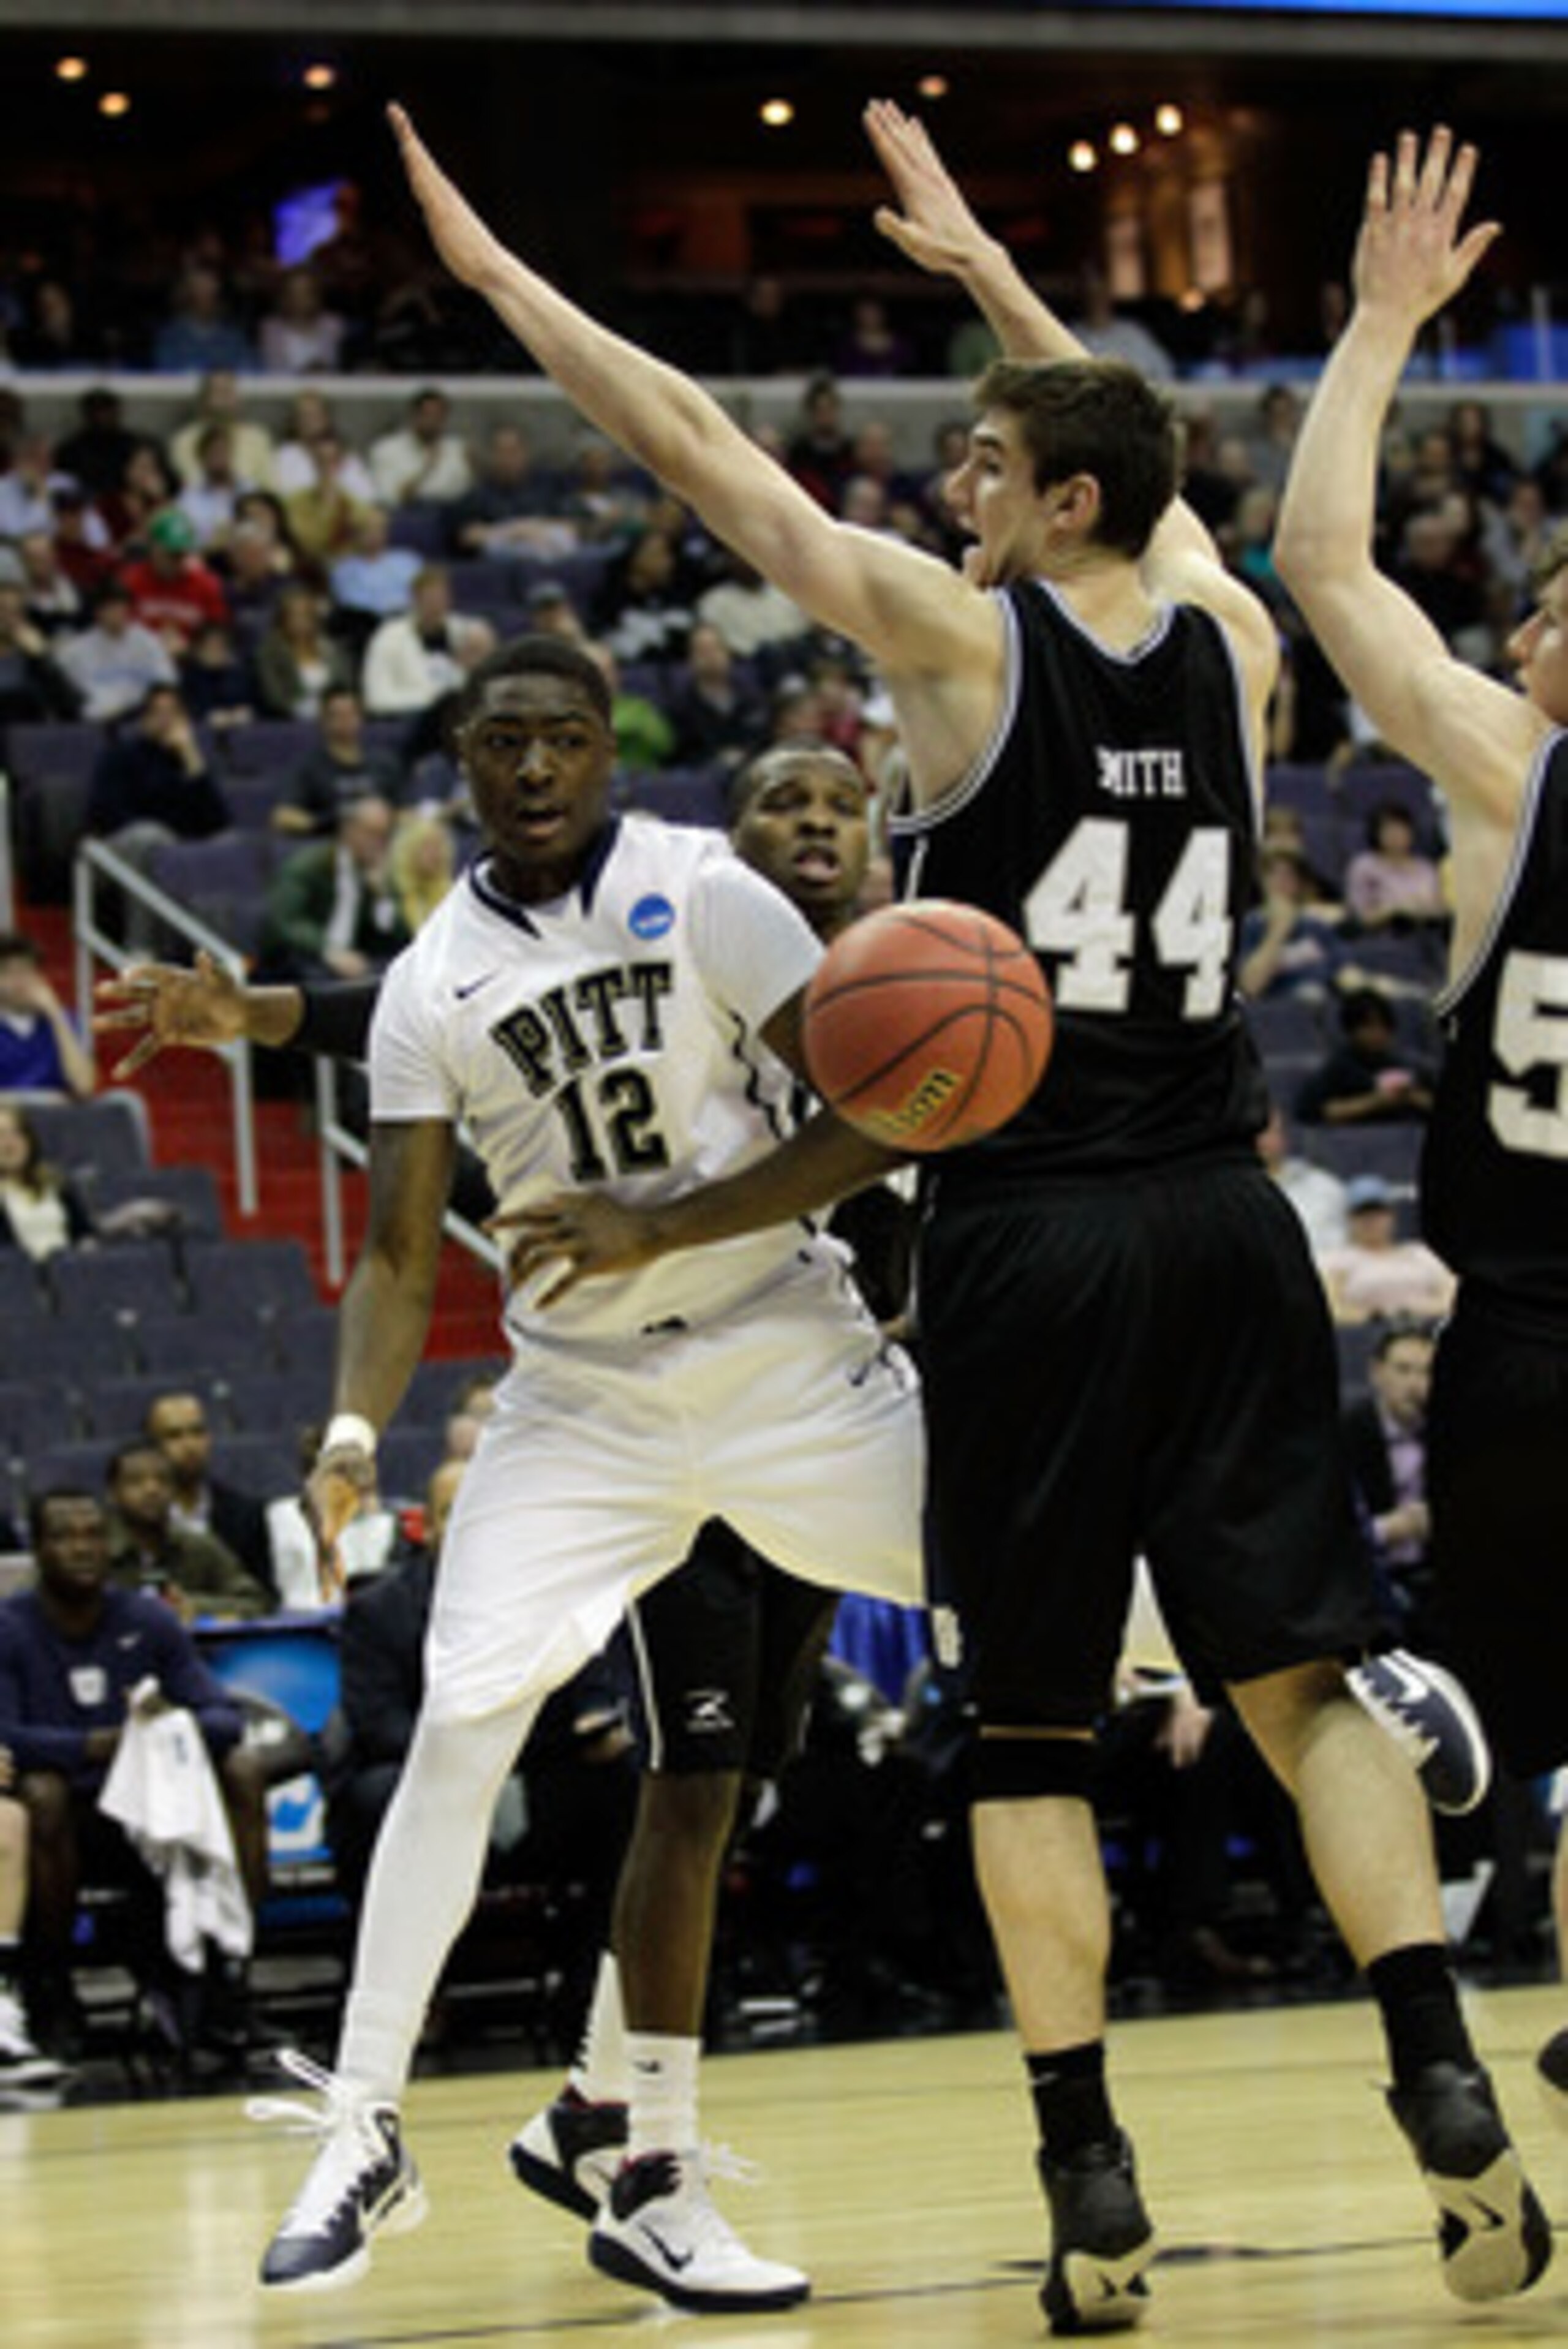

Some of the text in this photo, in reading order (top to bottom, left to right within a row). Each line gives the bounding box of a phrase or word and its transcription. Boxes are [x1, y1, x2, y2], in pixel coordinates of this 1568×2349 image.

[1022, 816, 1233, 1020] 44
[490, 962, 672, 1098] PITT
[1487, 950, 1568, 1159] 5
[555, 1068, 670, 1182] 12
